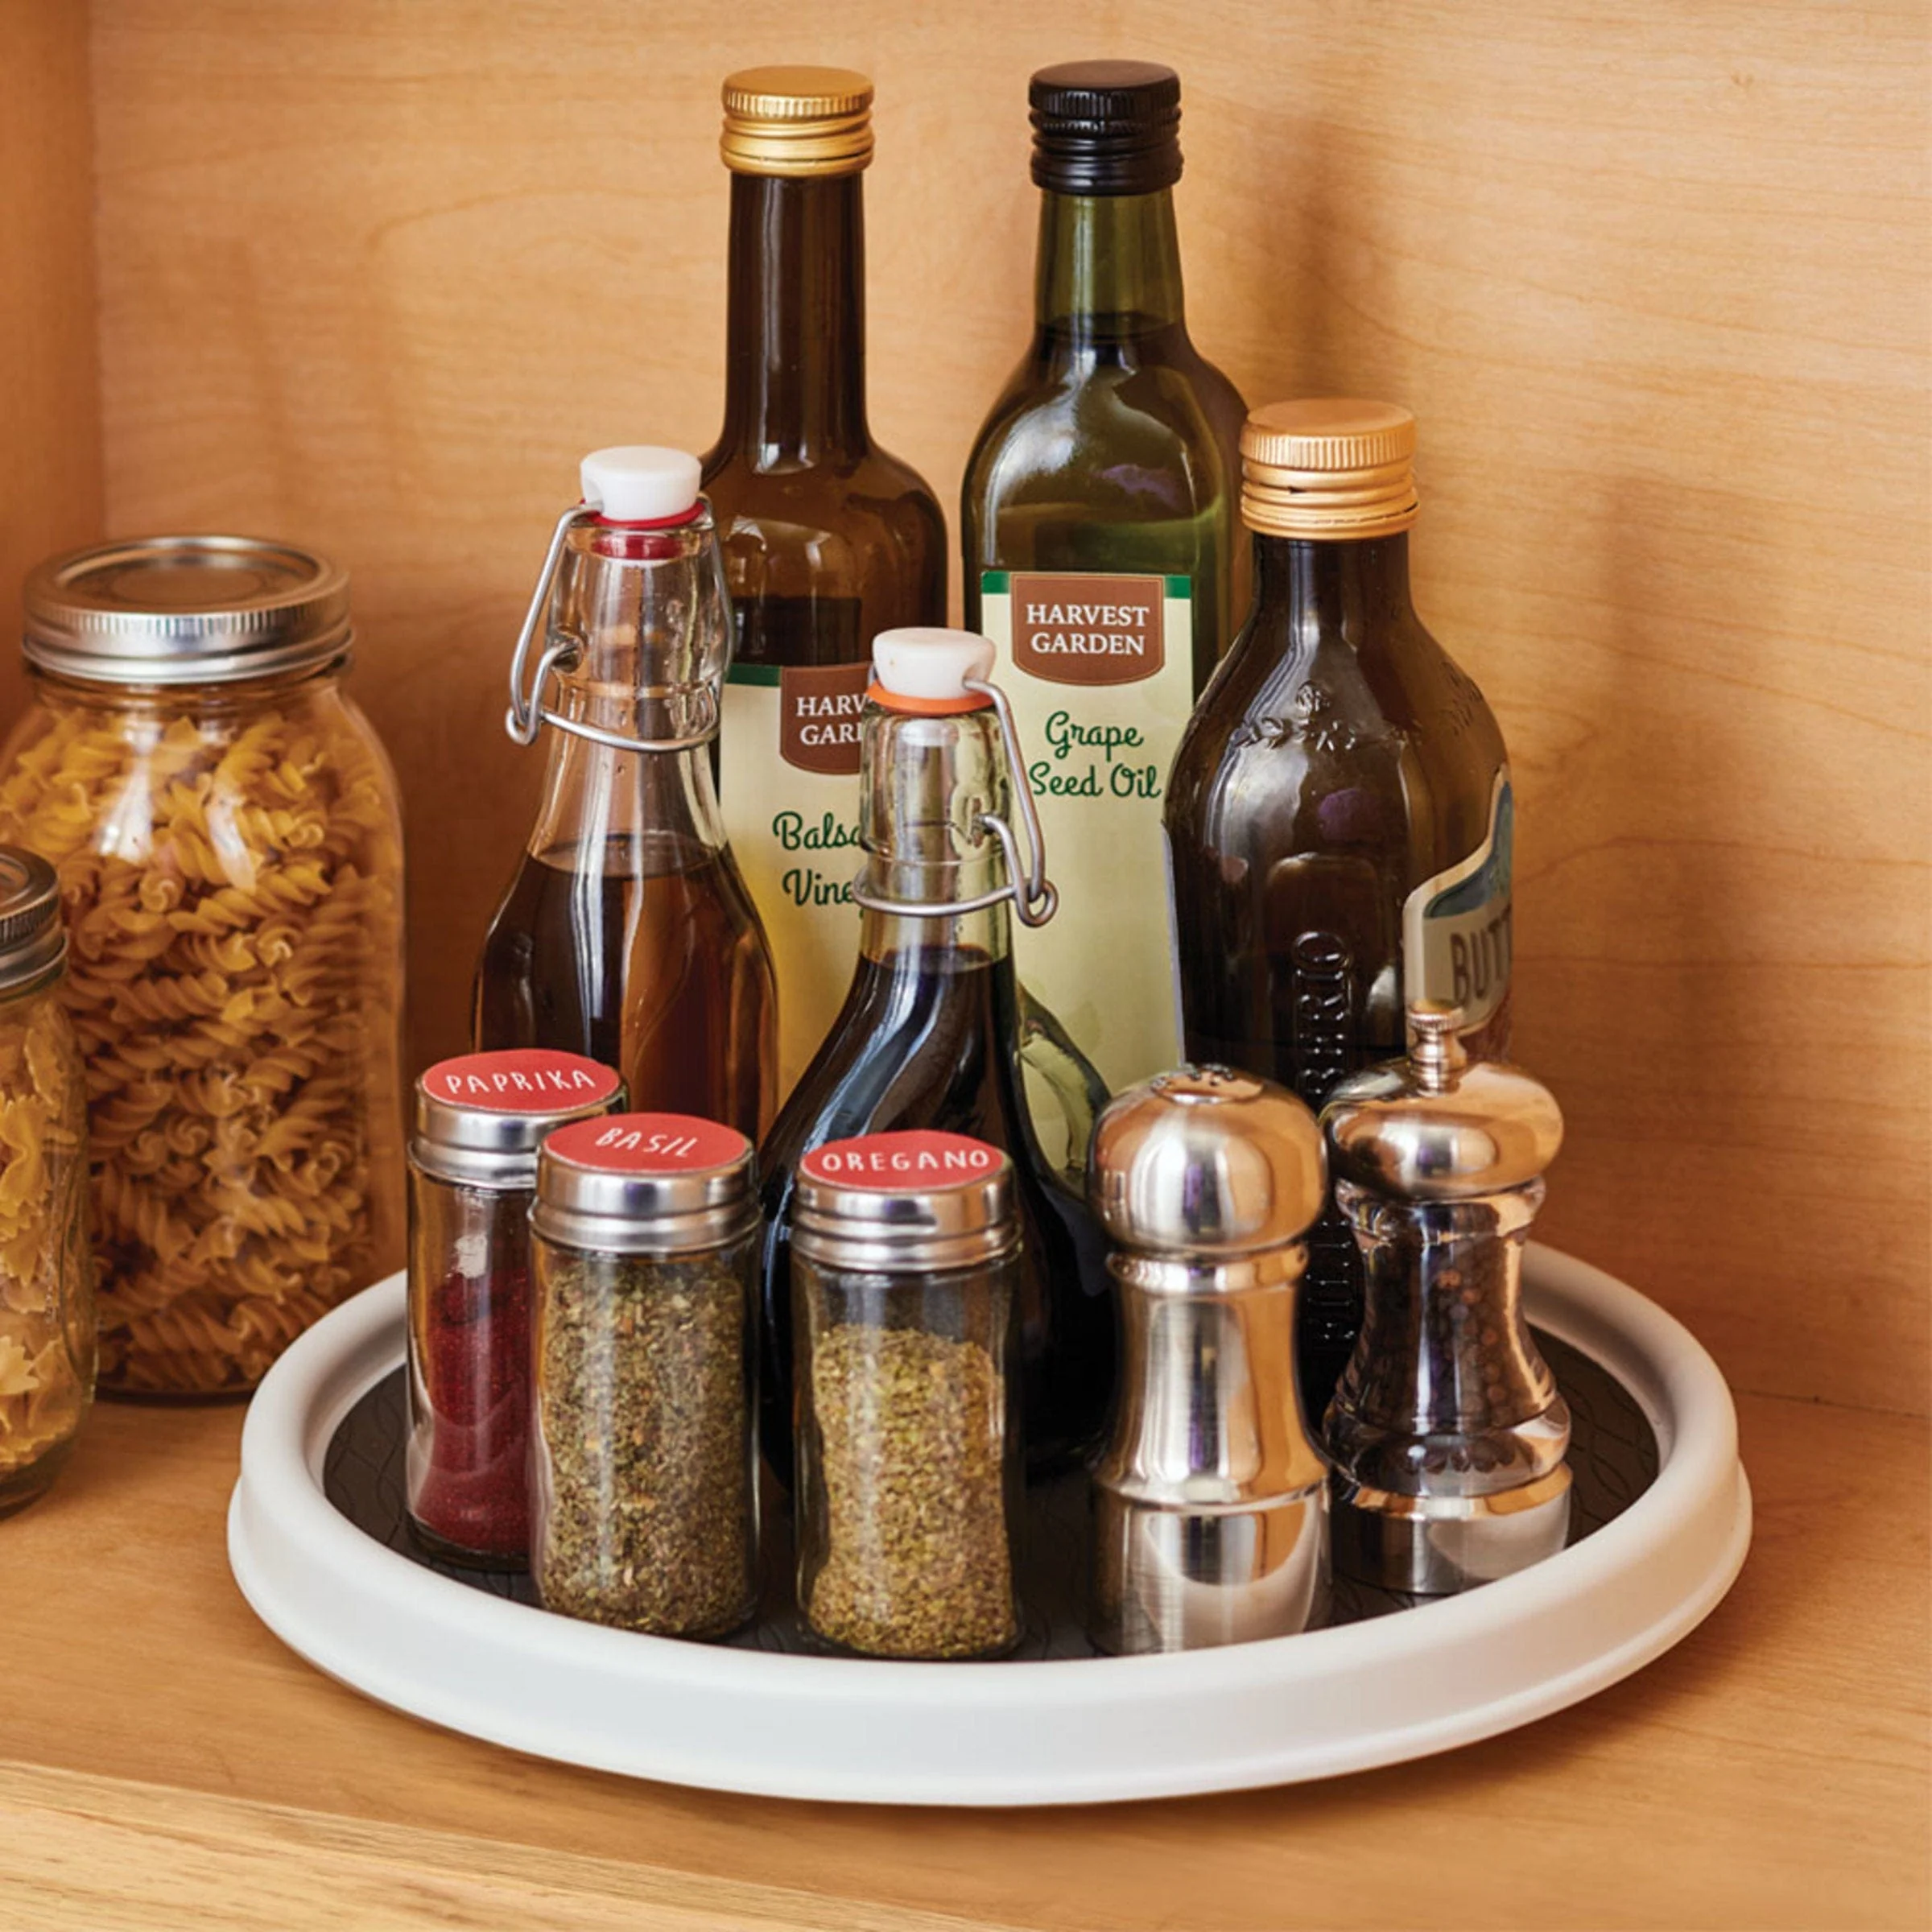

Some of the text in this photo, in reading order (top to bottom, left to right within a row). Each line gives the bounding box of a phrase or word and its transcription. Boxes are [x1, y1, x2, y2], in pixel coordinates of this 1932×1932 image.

[1026, 604, 1150, 626] HARVEST
[1030, 632, 1145, 656] GARDEN
[1045, 710, 1144, 762] Grape
[1029, 761, 1162, 798] Seed Oil
[445, 1069, 597, 1094] PAPRIKA
[595, 1127, 698, 1158] BASIL
[821, 1149, 989, 1172] OREGANO
